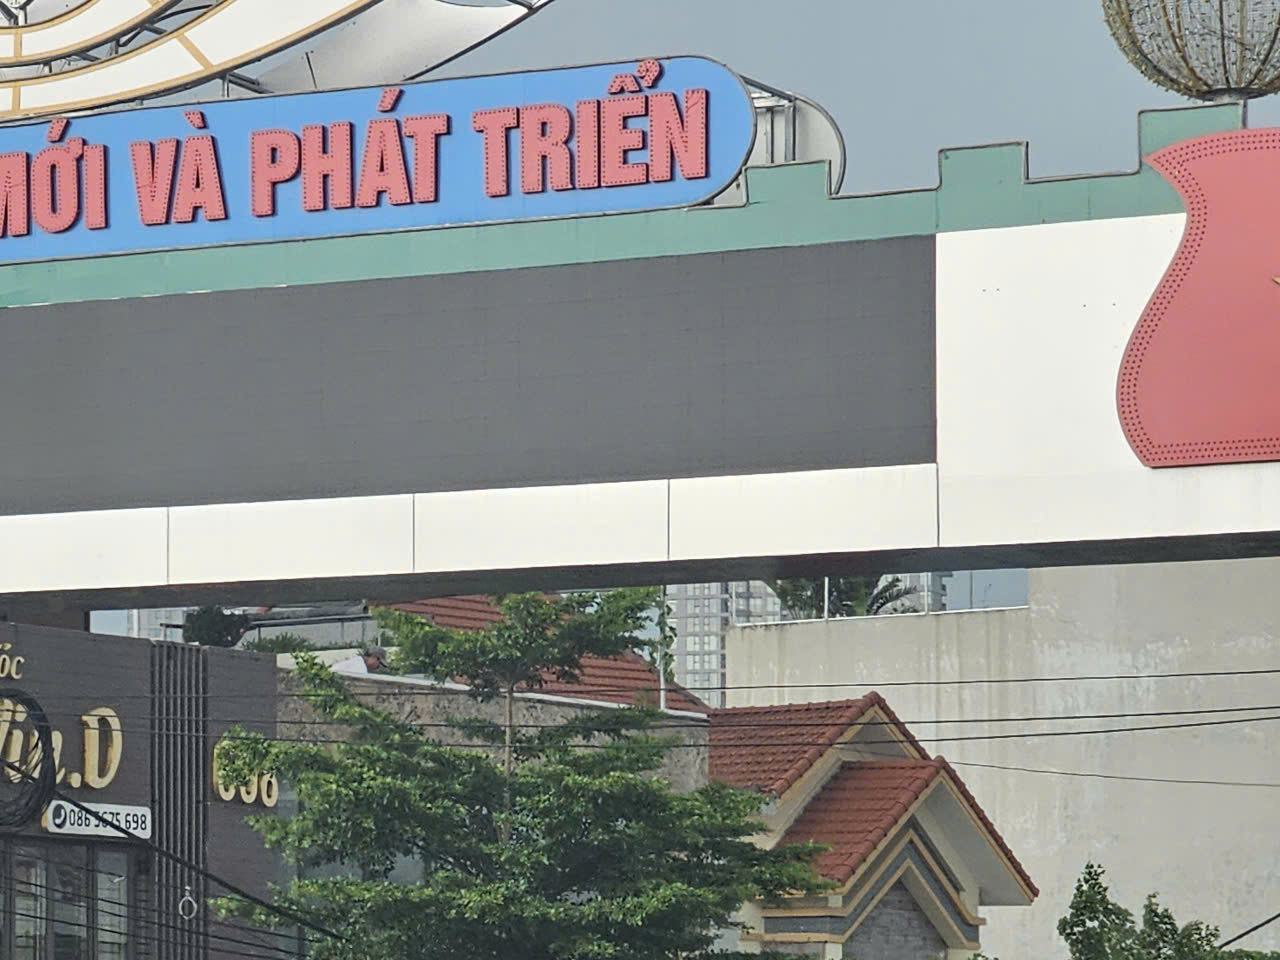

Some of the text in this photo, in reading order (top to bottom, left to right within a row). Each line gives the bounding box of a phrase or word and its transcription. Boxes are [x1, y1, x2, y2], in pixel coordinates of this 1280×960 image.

[128, 111, 229, 226] VÀ
[250, 88, 448, 216] PHÁT
[472, 59, 708, 197] TRIỂN
[69, 809, 91, 828] 086
[125, 813, 148, 831] 698
